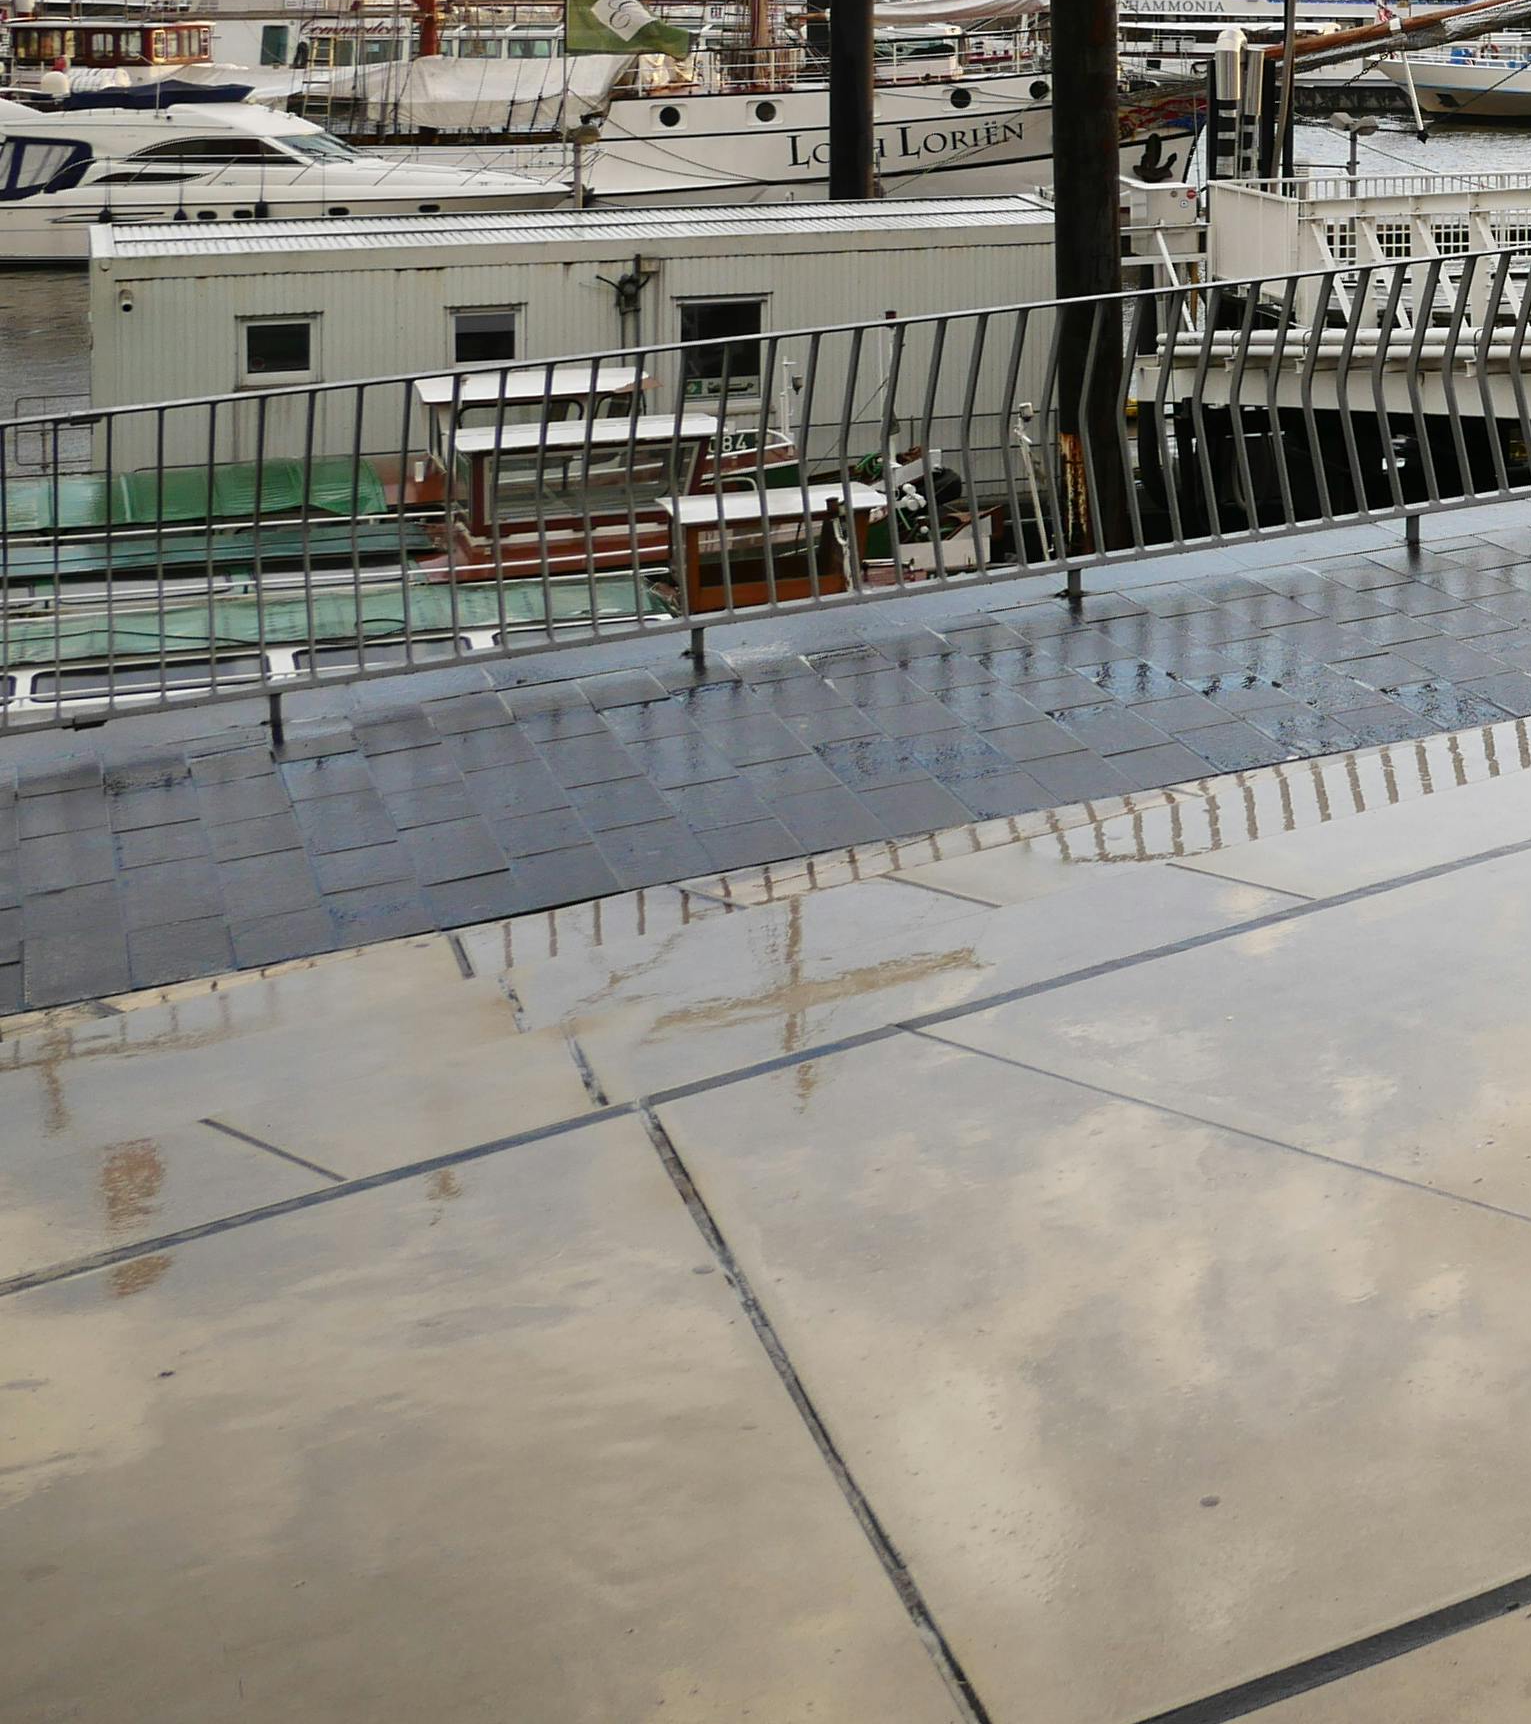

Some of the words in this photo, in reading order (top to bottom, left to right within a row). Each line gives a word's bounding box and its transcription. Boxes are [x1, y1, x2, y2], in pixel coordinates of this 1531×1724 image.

[1128, 0, 1226, 13] HAMMONIA
[786, 134, 887, 169] LOH
[898, 120, 1025, 160] LORIËN
